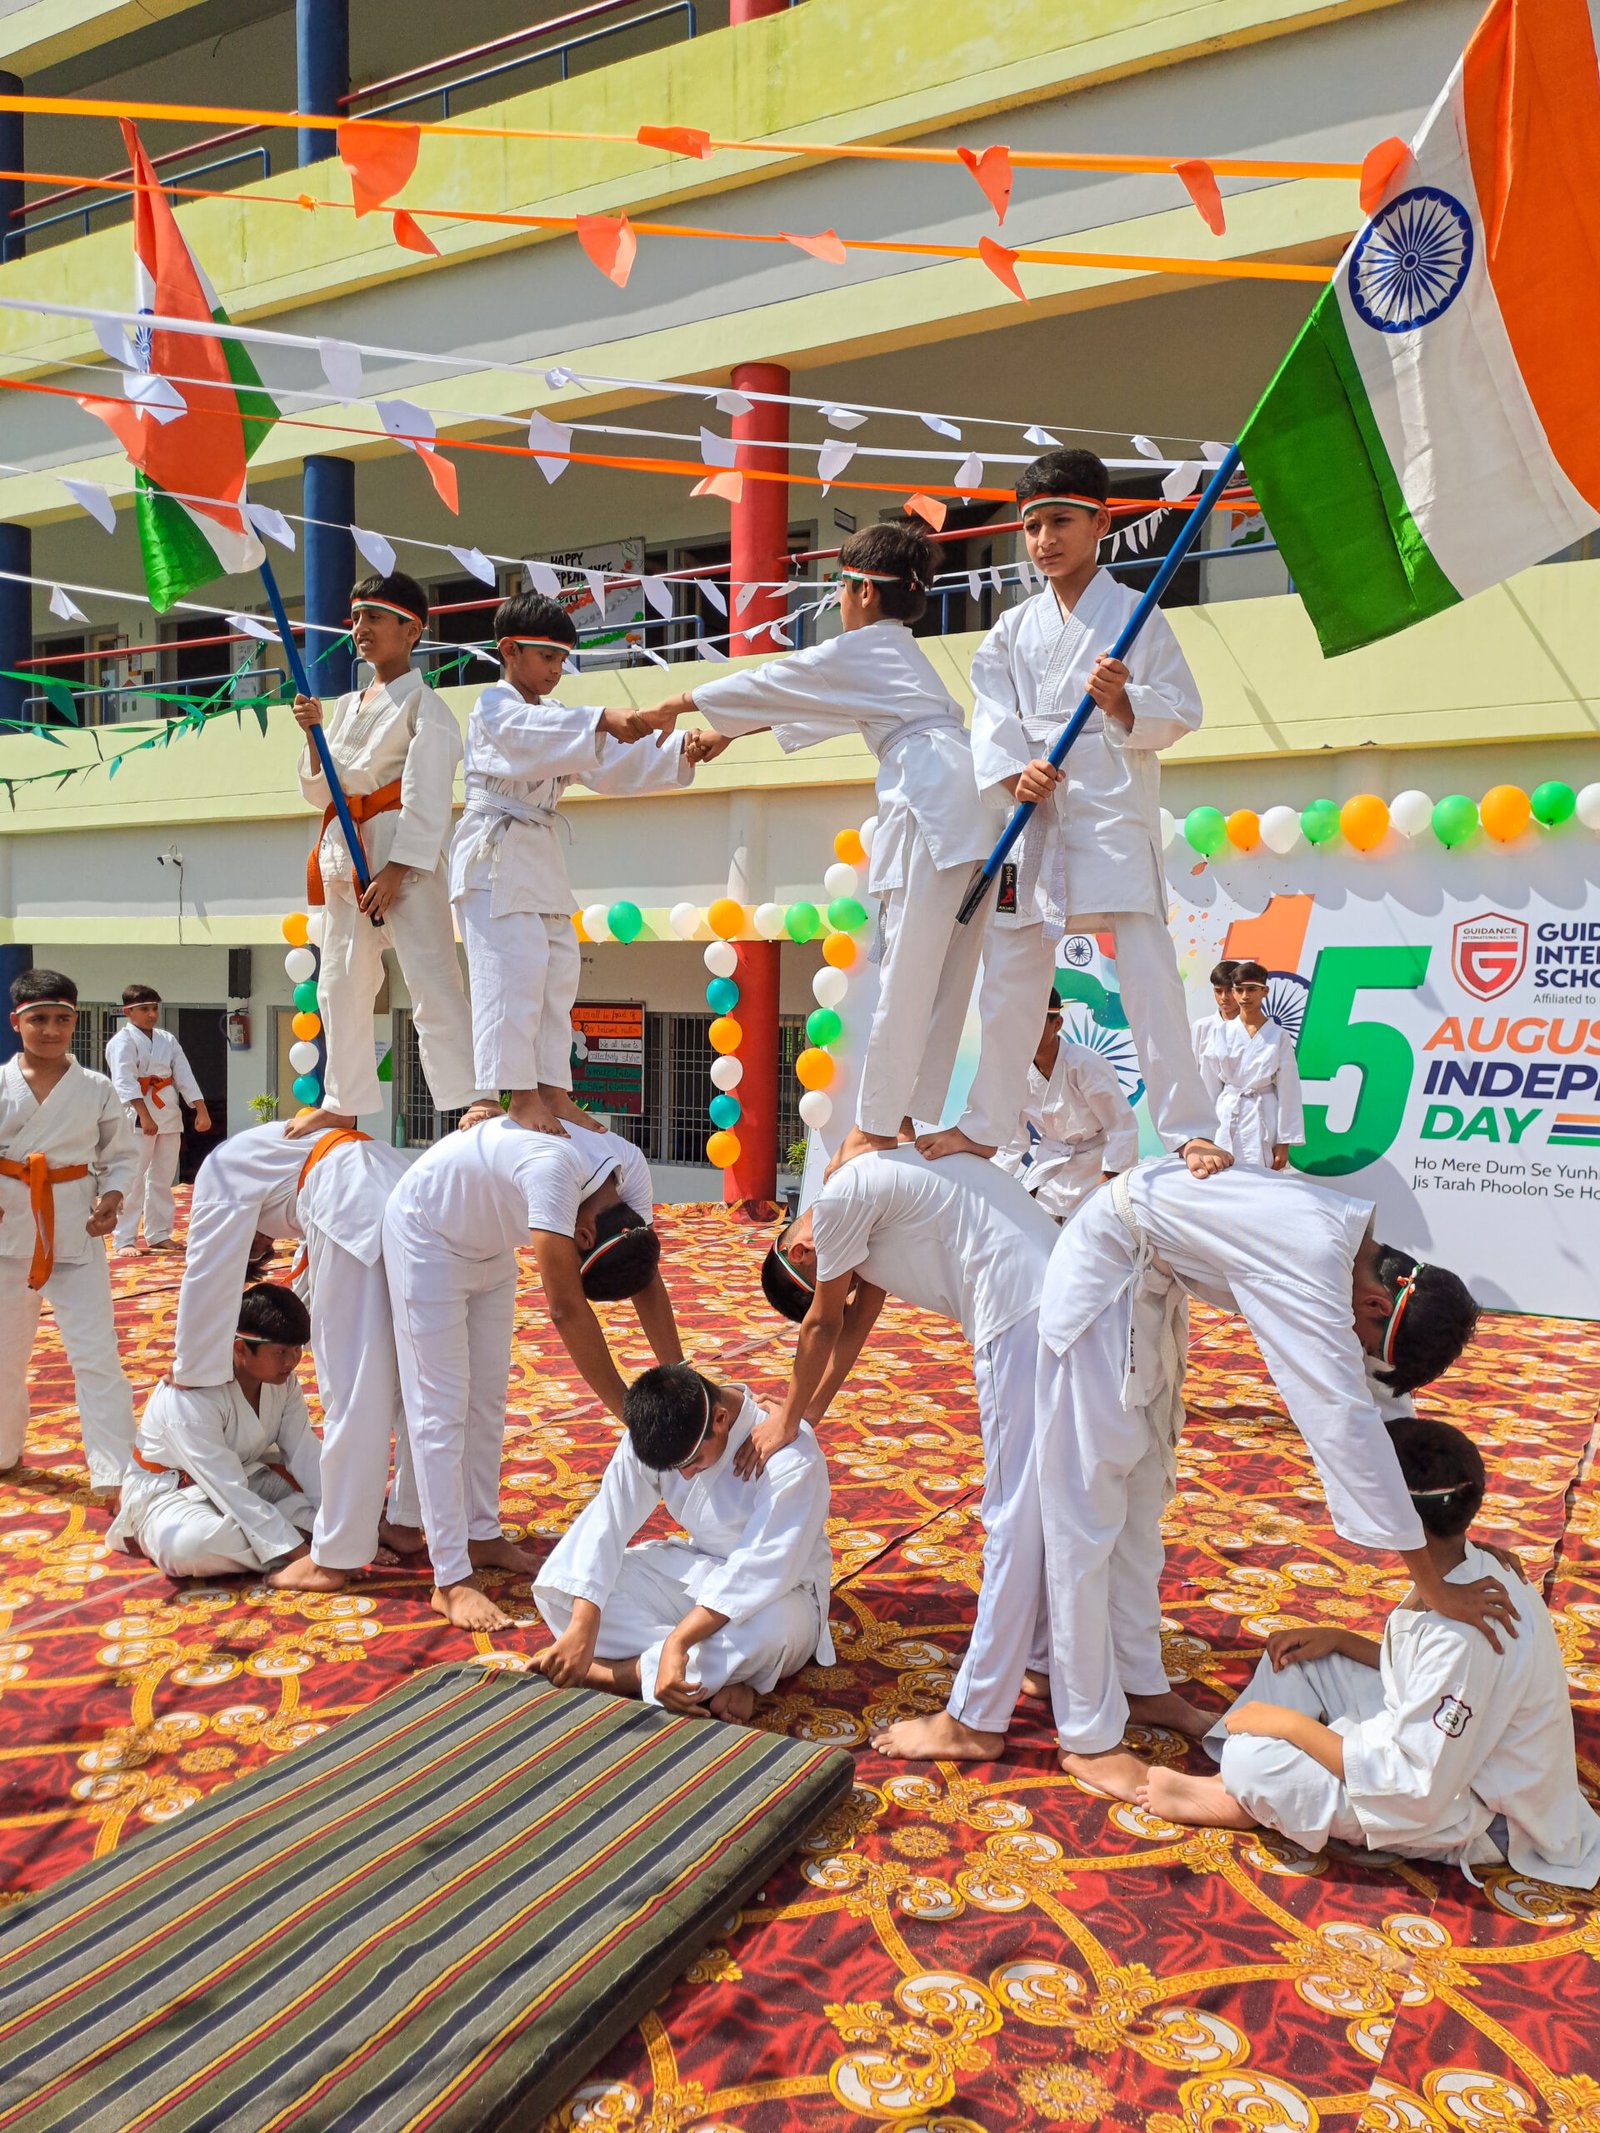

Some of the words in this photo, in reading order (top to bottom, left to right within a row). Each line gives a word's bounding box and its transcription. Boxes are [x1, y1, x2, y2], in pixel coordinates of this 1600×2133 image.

[551, 552, 583, 567] HAPPY
[1463, 927, 1517, 935] GUIDANCE
[1537, 922, 1600, 942] GUID
[1536, 946, 1600, 965] INTE
[1533, 993, 1583, 1004] Affiliated
[1585, 995, 1597, 1004] to
[1423, 1060, 1600, 1101] INDEP
[1419, 1104, 1543, 1144] DAY
[1414, 1156, 1437, 1170] Ho
[1441, 1158, 1481, 1173] Mere
[1486, 1160, 1526, 1175] Dum
[1531, 1163, 1552, 1178] Se
[1557, 1164, 1600, 1180] Yunh
[1412, 1175, 1429, 1190] Jis
[1434, 1176, 1475, 1192] Tarah
[1480, 1179, 1548, 1197] Phoolon
[1553, 1184, 1575, 1198] Se
